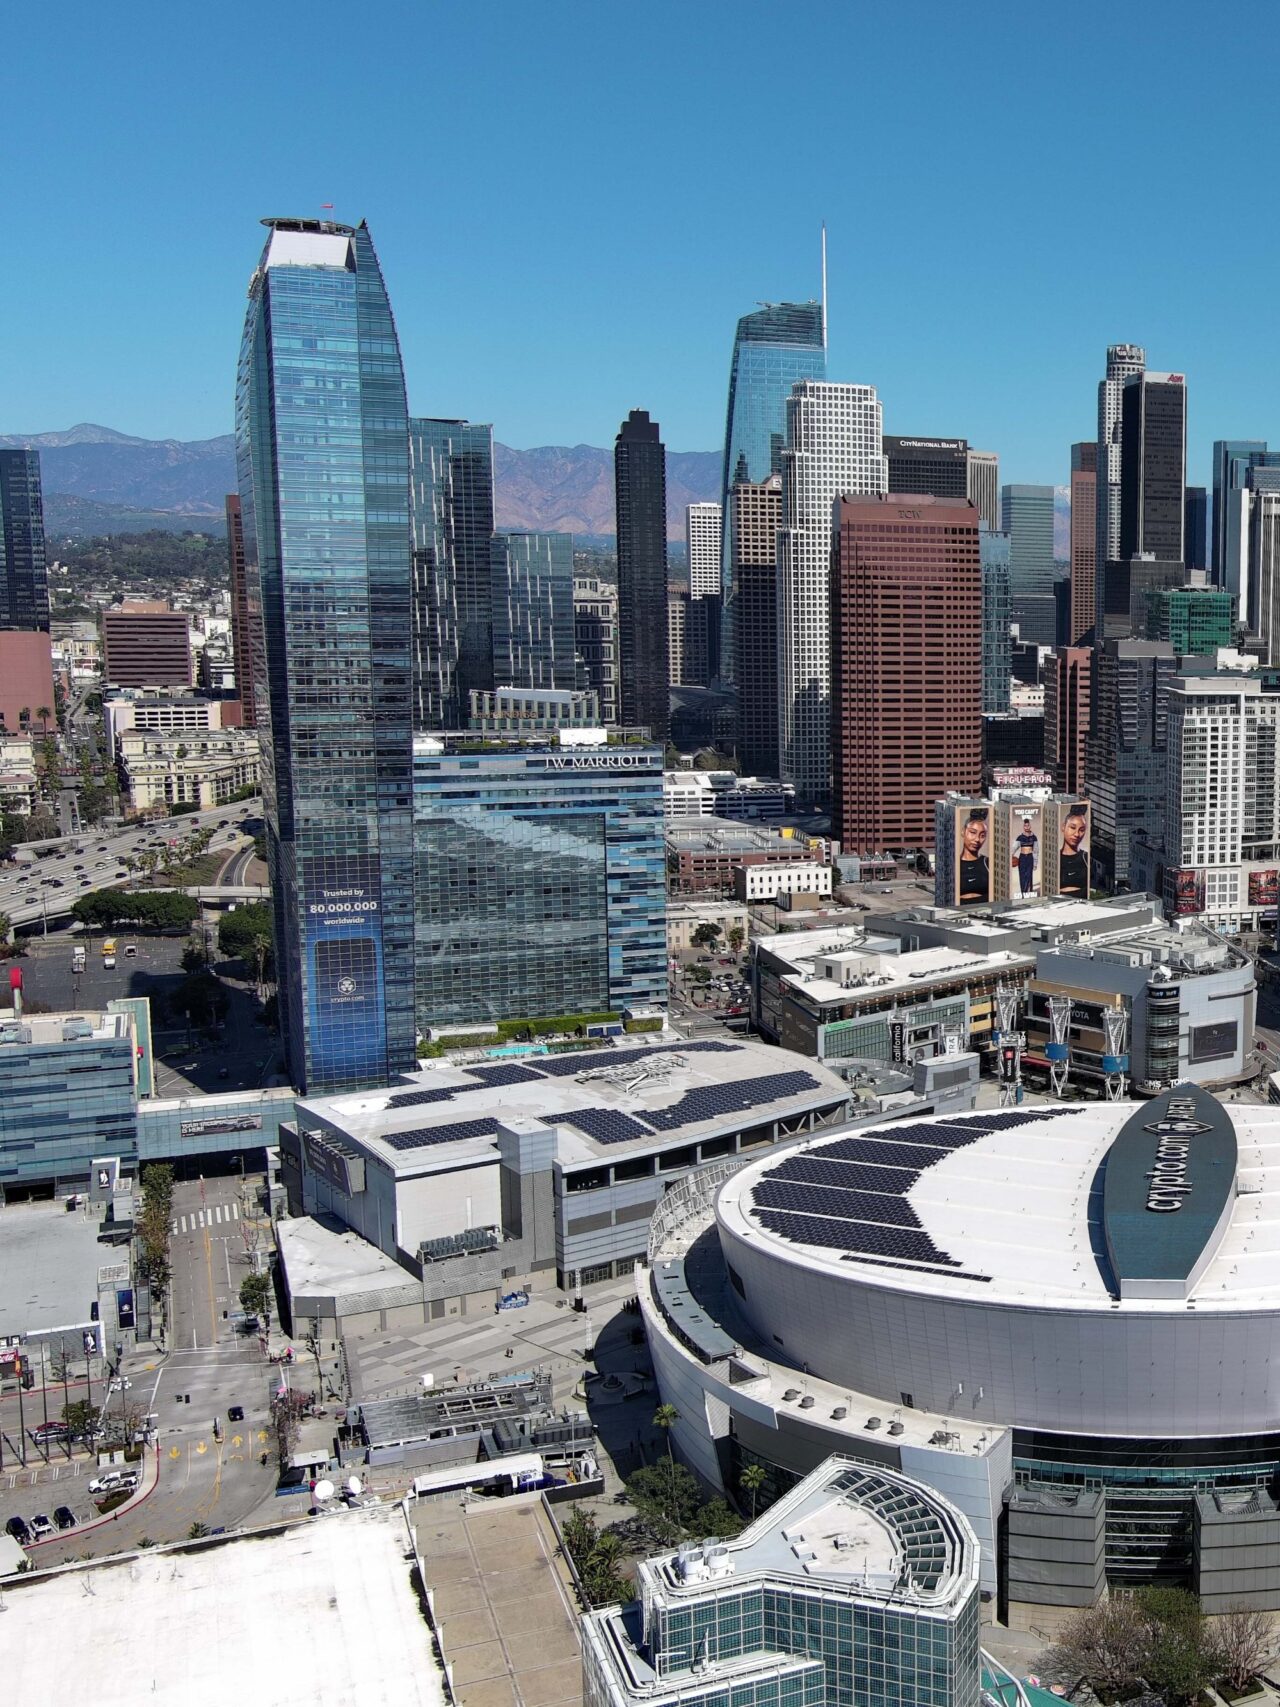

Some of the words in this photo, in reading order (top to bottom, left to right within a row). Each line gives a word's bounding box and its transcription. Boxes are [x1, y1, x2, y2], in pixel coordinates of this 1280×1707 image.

[898, 510, 922, 519] TCW
[544, 757, 566, 770] JW
[571, 755, 653, 768] MARRIOTT
[996, 775, 1052, 785] FIGUEROA
[322, 889, 352, 897] Trusted
[354, 889, 365, 897] by
[310, 902, 378, 914] 80,000,000
[323, 916, 366, 925] worldwide
[330, 995, 365, 1003] crypto.com
[1071, 1010, 1090, 1020] YOTA
[1166, 1097, 1197, 1120] ARENA
[1146, 1135, 1193, 1211] crypto.com
